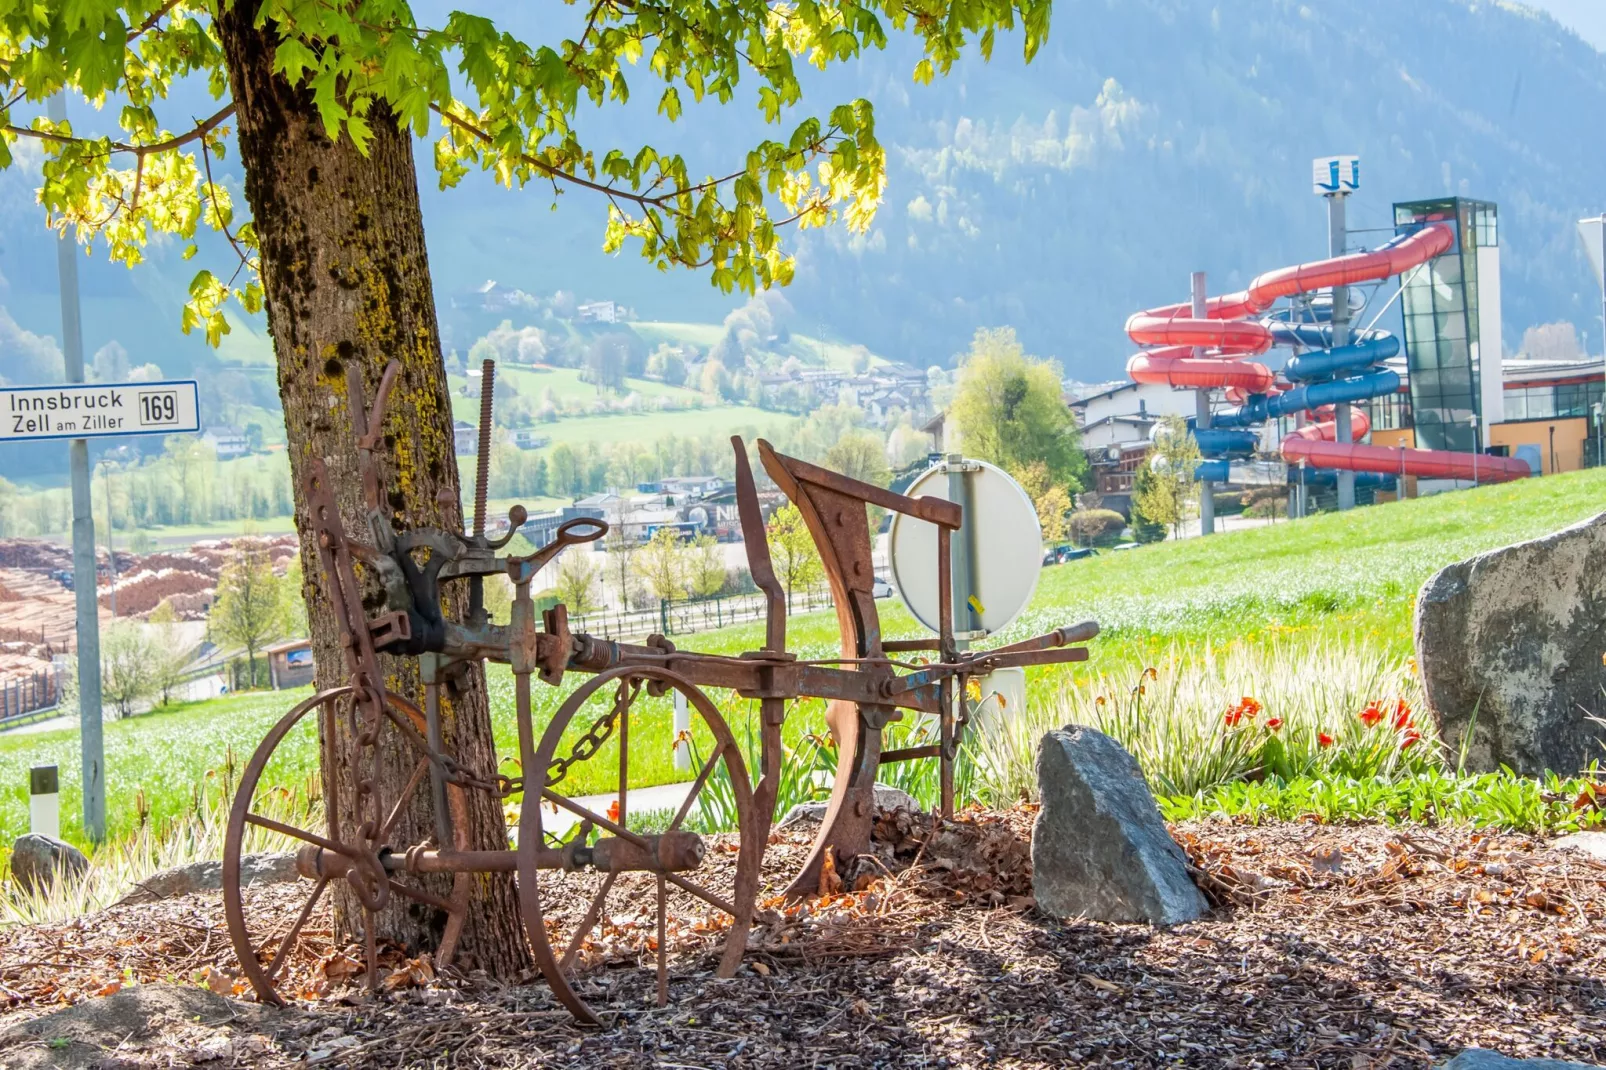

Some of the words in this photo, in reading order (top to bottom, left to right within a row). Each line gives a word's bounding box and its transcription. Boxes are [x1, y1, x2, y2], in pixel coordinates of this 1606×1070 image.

[11, 390, 123, 411] Innsbruck
[141, 395, 175, 421] 169
[12, 414, 50, 433] Zell
[56, 420, 76, 431] am
[82, 416, 124, 430] Ziller
